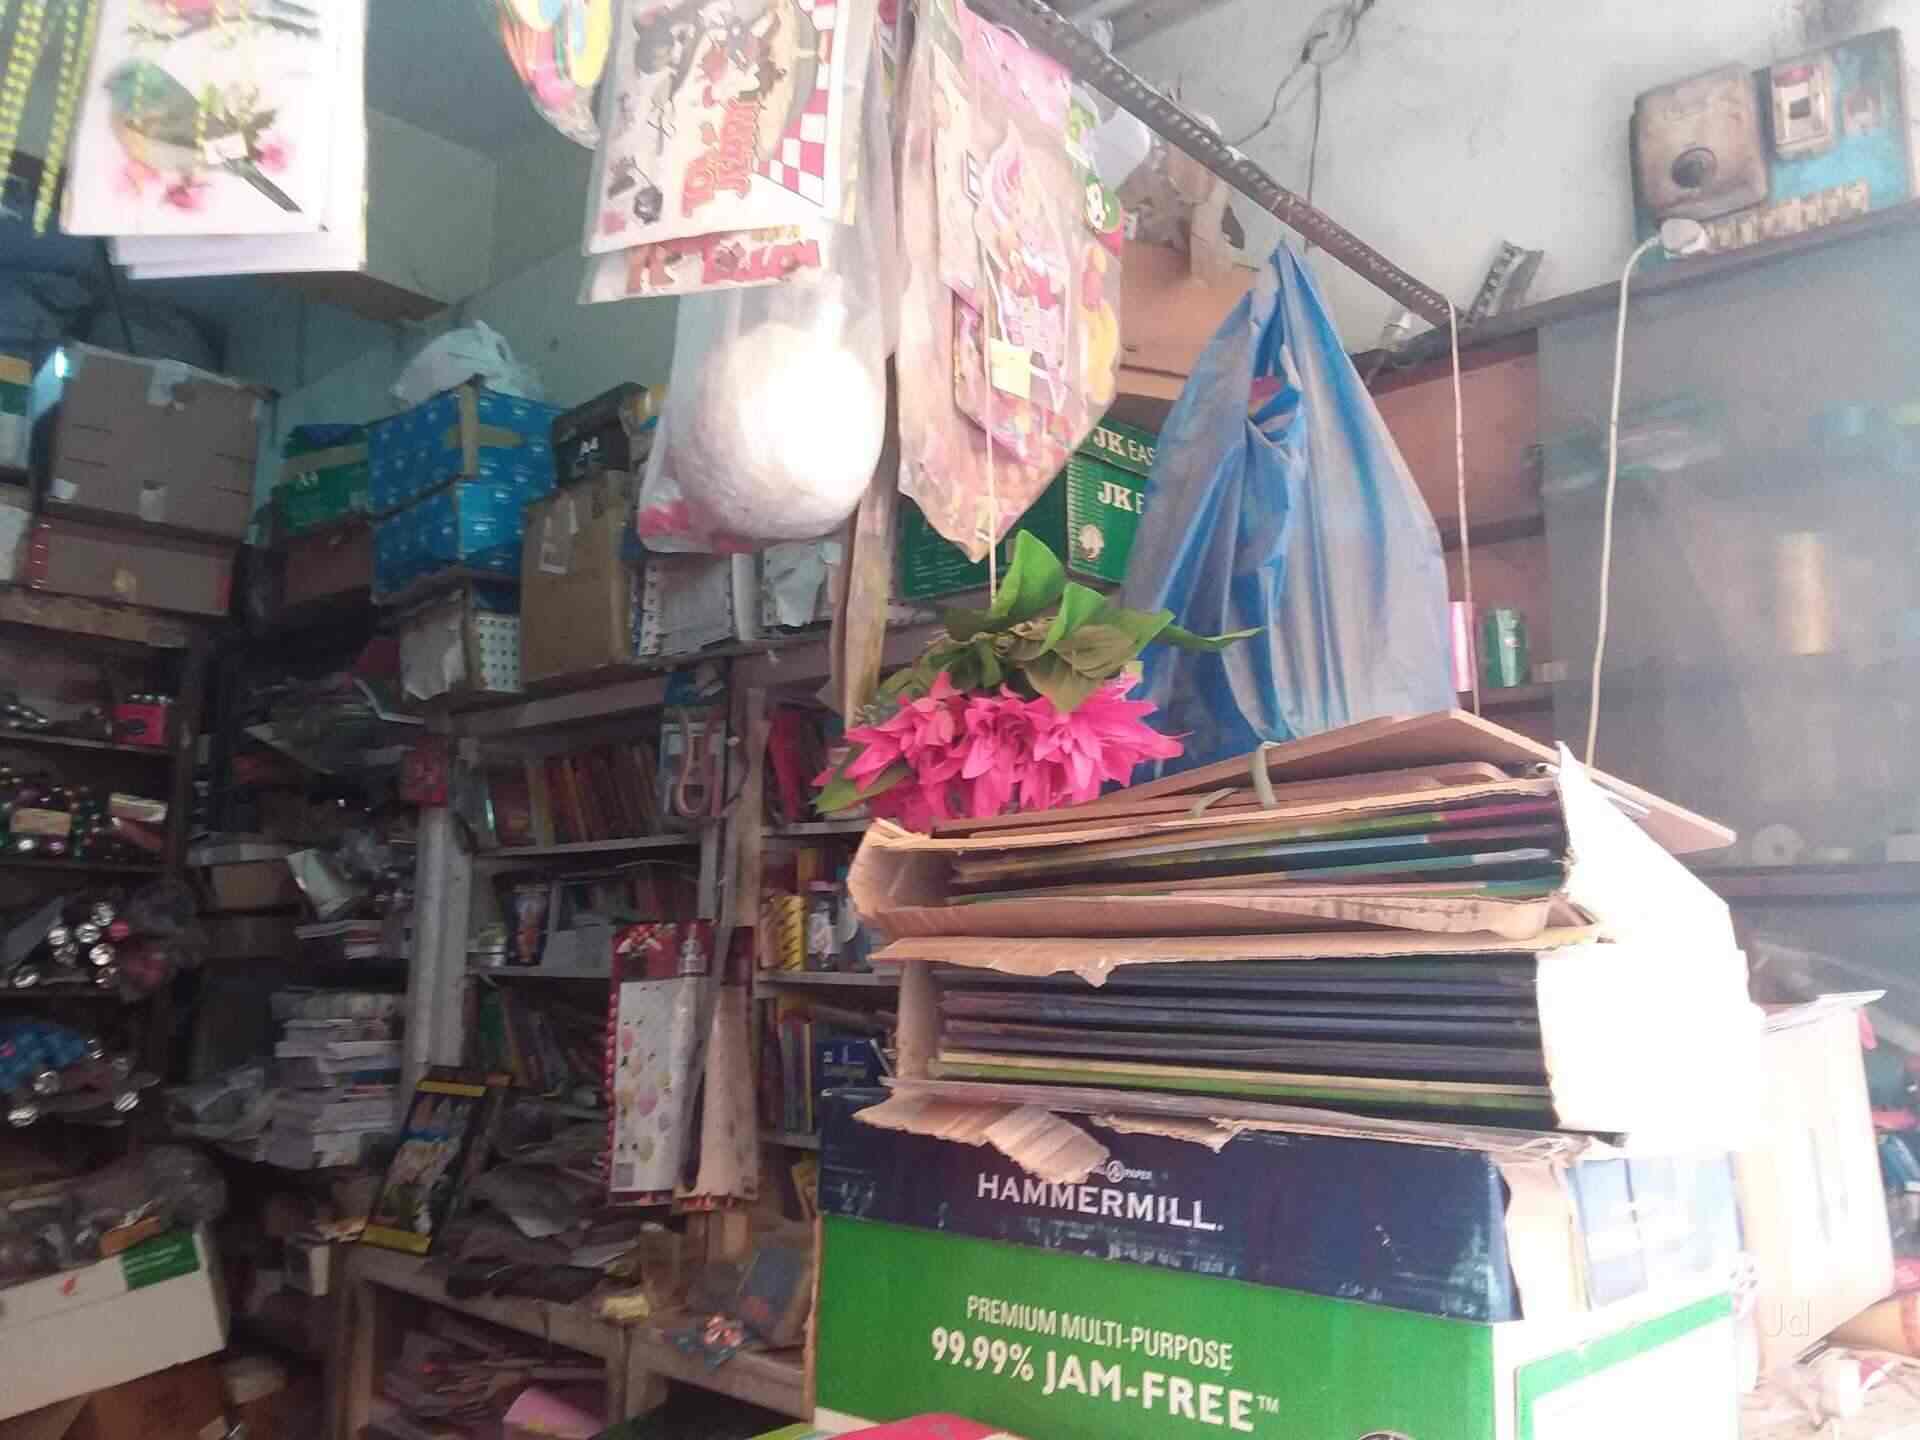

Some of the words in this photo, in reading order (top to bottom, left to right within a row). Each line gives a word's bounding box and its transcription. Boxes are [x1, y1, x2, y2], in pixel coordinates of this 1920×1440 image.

[1092, 426, 1127, 456] JK
[1097, 480, 1133, 511] JK
[931, 1326, 1034, 1382] 99.99%
[967, 1295, 1057, 1336] PREMIUM
[1061, 1312, 1233, 1372] MULTI-PURPOSE
